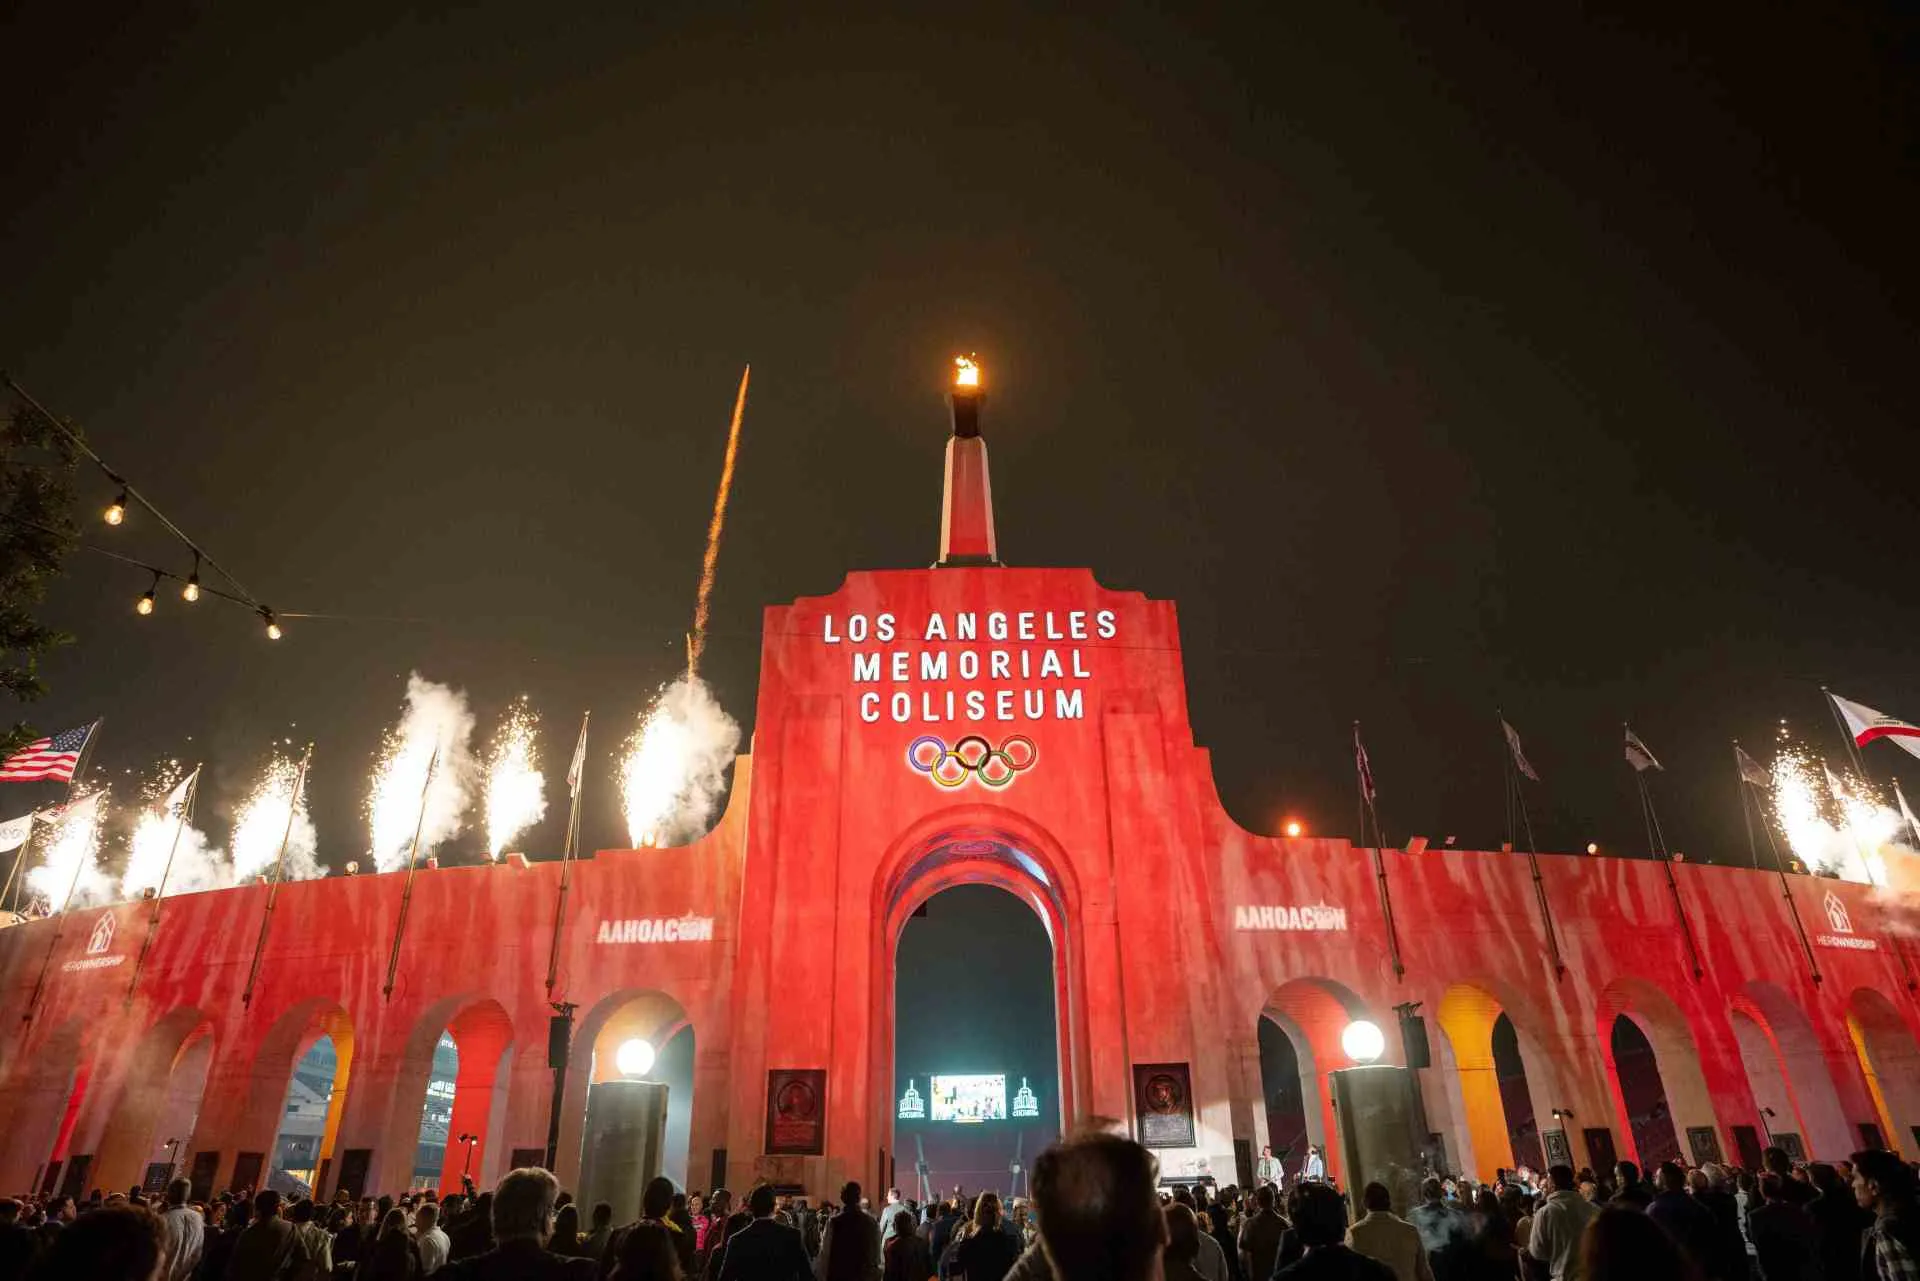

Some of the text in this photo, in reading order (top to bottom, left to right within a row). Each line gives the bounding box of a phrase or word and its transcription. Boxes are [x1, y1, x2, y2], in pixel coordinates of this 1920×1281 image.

[824, 610, 1117, 643] LOS ANGELES
[854, 649, 1091, 682] MEMORIAL
[861, 689, 1084, 722] COLISEUM
